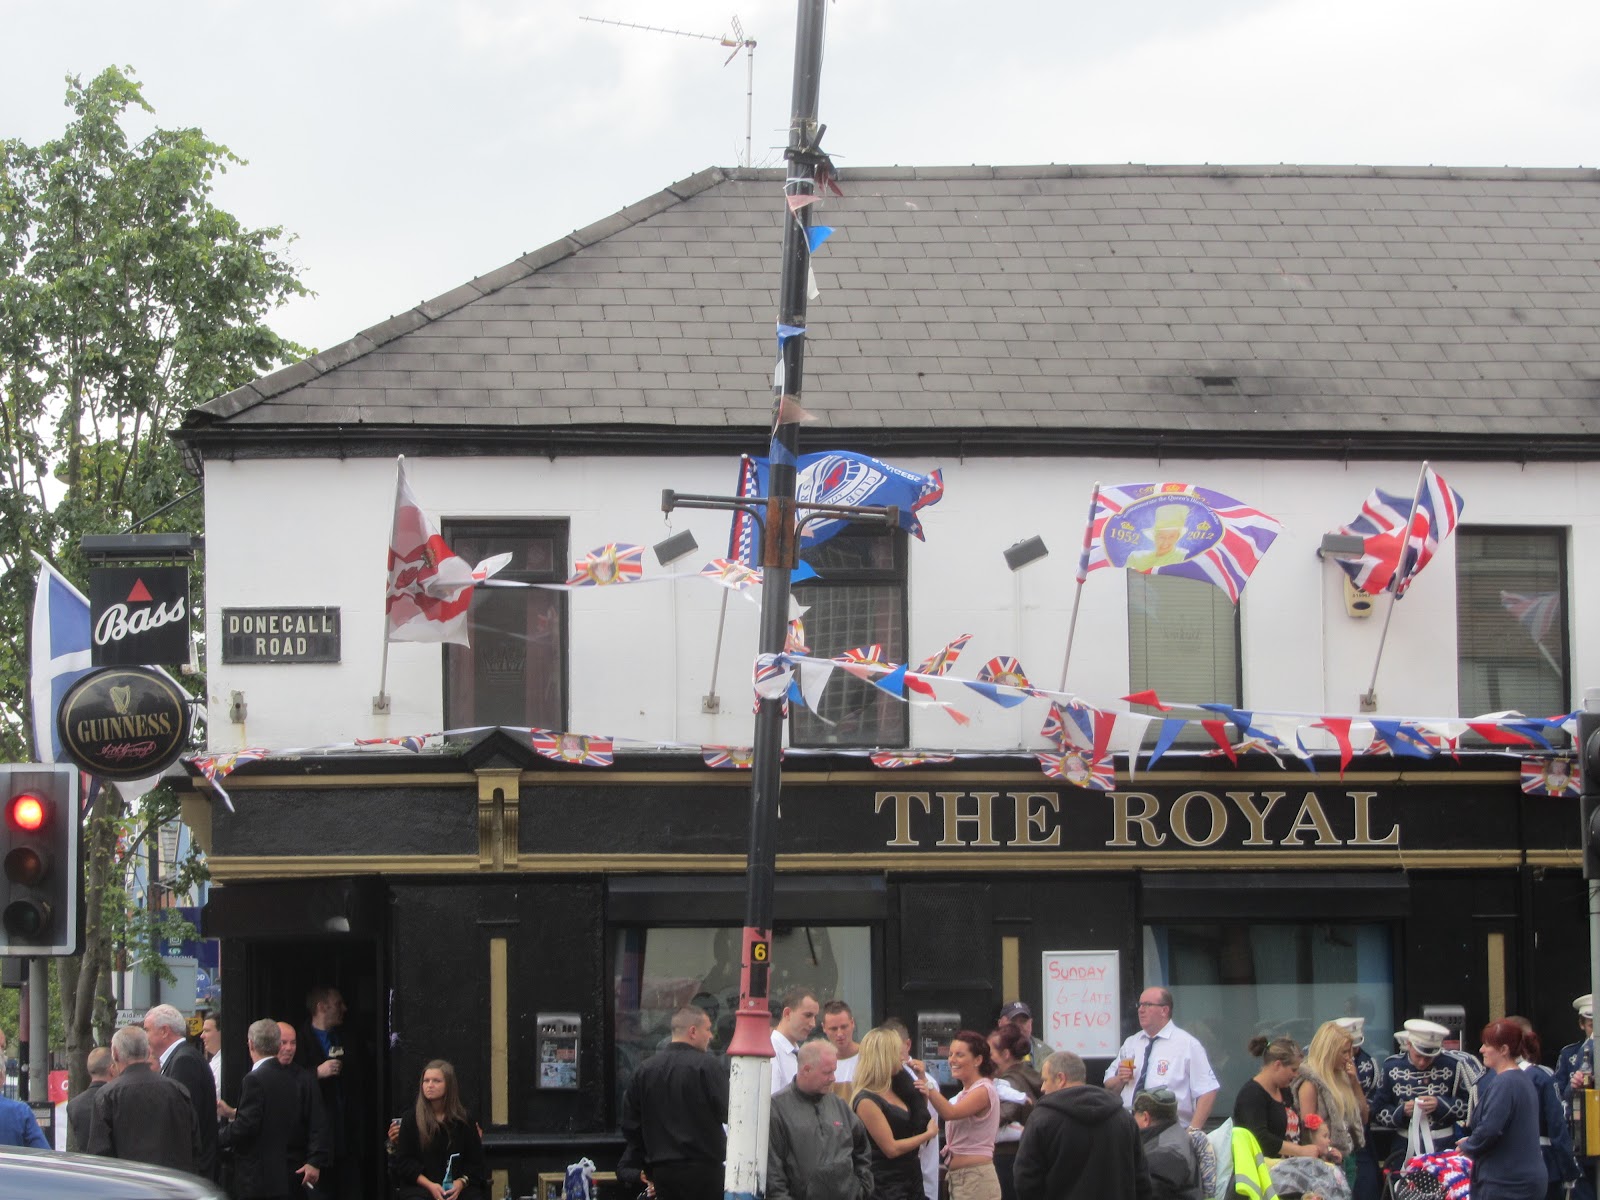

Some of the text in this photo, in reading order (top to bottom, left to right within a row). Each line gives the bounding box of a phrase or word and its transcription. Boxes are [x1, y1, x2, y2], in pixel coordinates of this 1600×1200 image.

[1110, 528, 1140, 545] 1952
[1187, 531, 1215, 541] 2012
[94, 597, 186, 646] Bass
[229, 615, 332, 634] DONEGALL
[256, 637, 307, 656] ROAD
[77, 712, 170, 744] GUINNESS
[874, 790, 1400, 847] THE ROYAL
[754, 943, 766, 961] 6
[1052, 1011, 1111, 1030] STEVO
